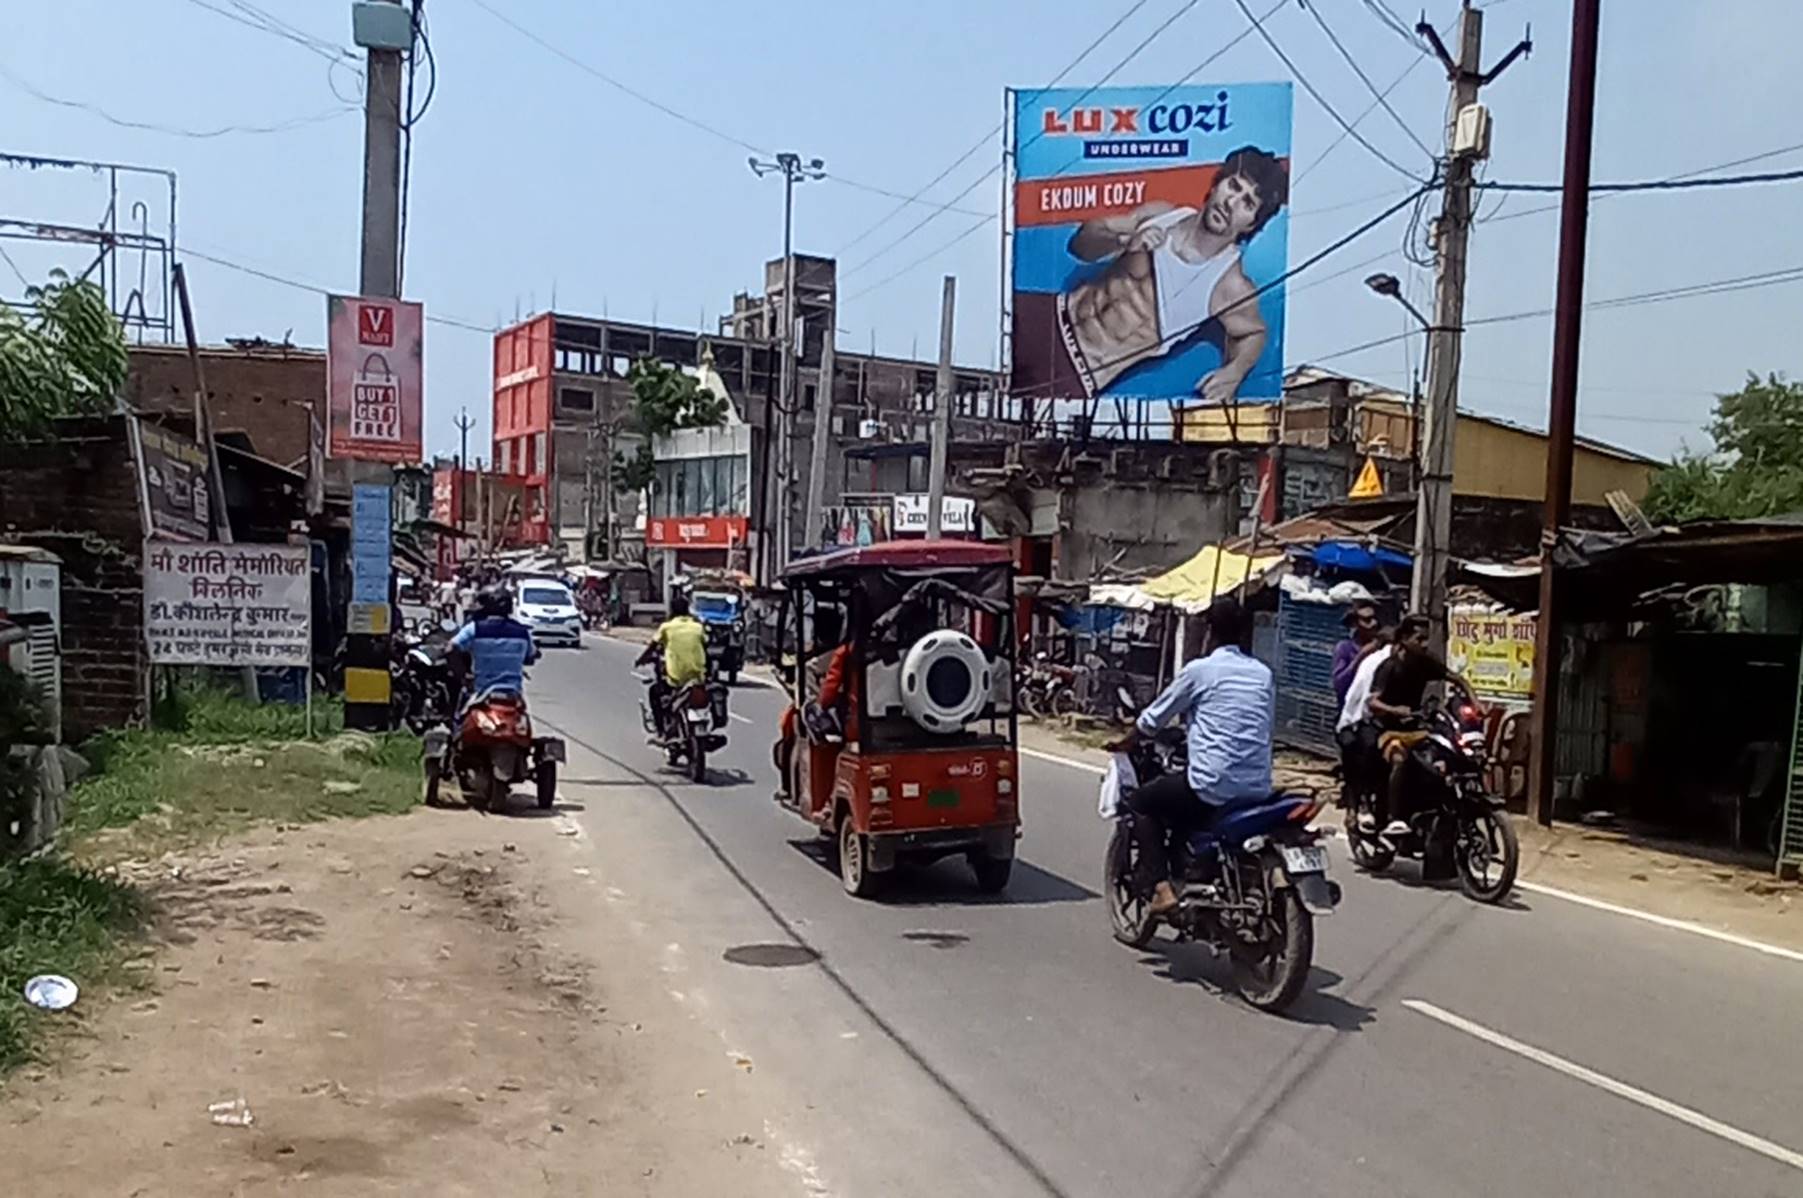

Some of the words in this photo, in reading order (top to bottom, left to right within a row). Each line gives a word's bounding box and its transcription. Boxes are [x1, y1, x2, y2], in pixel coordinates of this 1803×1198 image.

[1044, 109, 1138, 133] LUX
[1150, 91, 1232, 133] cozi
[1090, 143, 1180, 155] UNDERWEAR
[1041, 185, 1097, 211] EKDUM
[1104, 181, 1145, 206] COZY
[367, 308, 385, 332] V
[356, 387, 384, 402] BUY
[357, 404, 384, 422] GET
[354, 422, 396, 437] FREE
